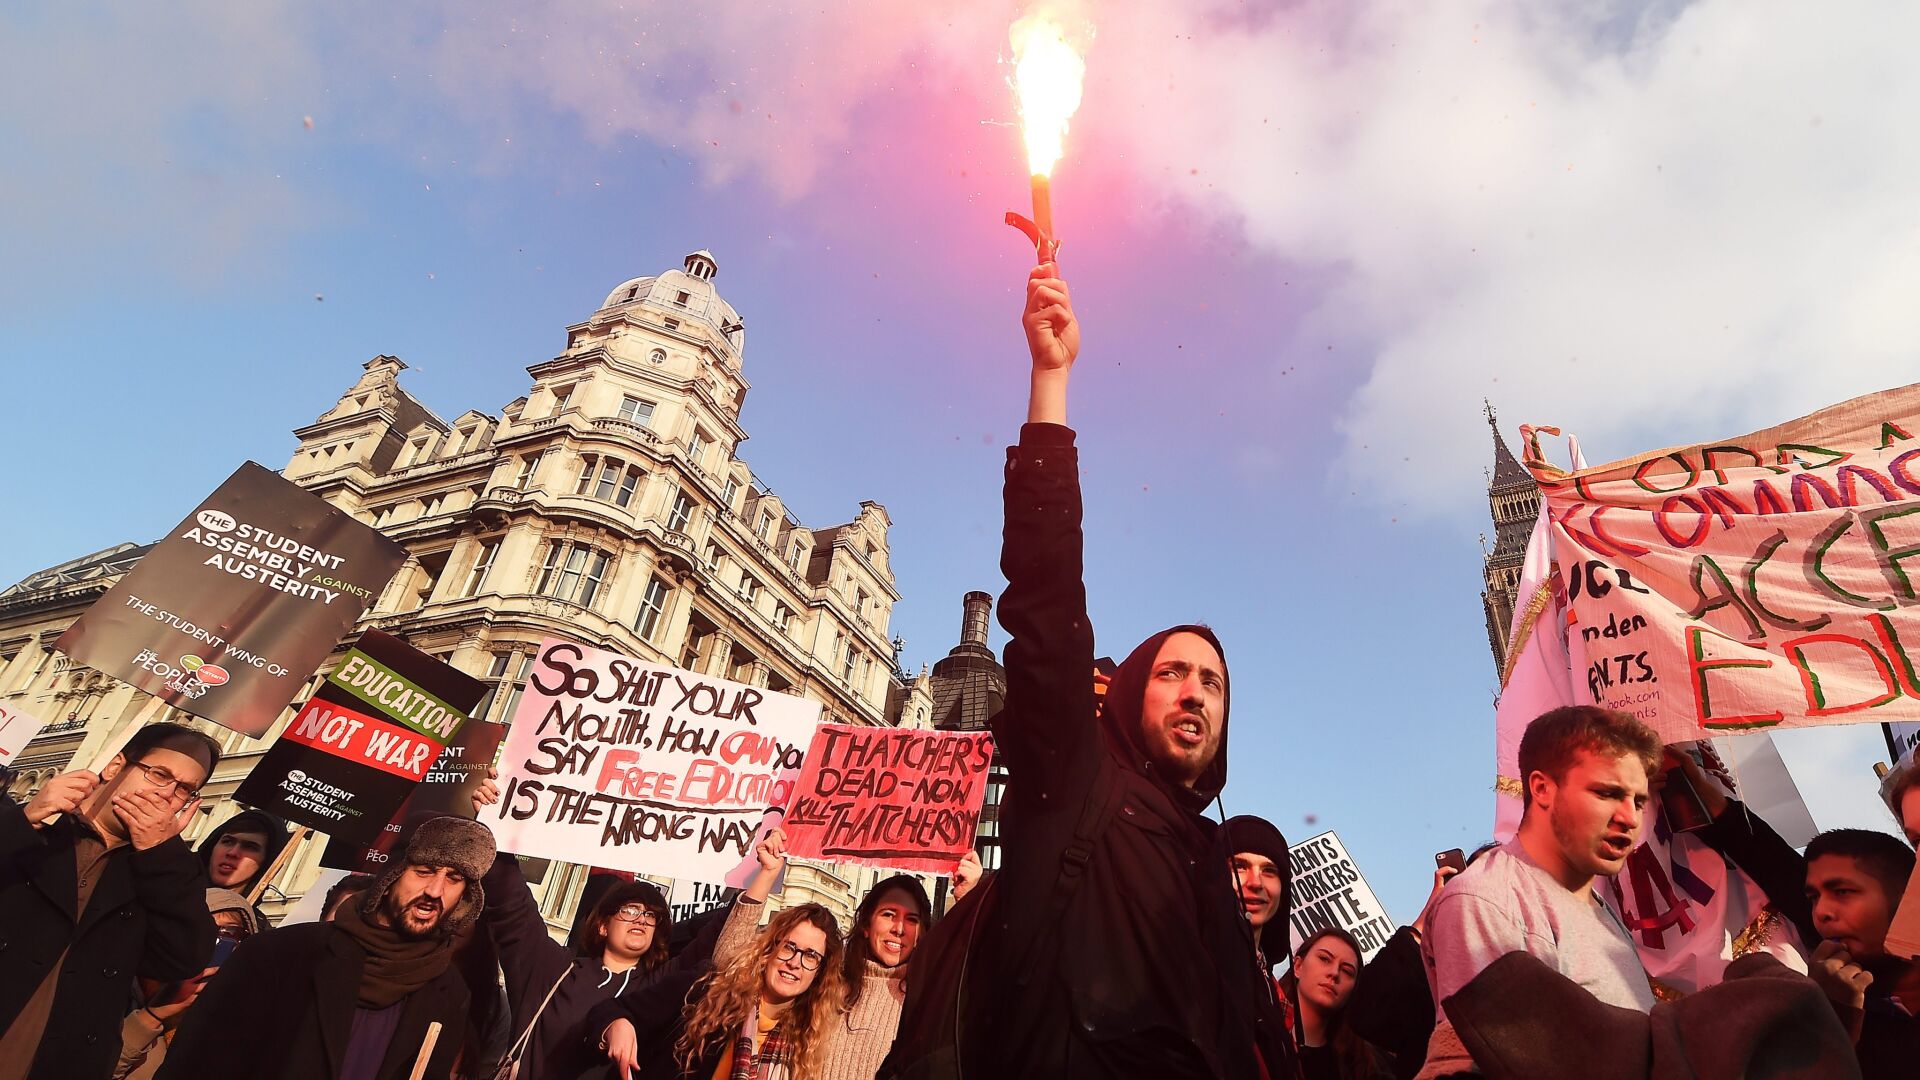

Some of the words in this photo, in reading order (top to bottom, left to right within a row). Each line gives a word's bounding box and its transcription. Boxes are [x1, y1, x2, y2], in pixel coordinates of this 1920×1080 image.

[201, 513, 231, 529] THE
[235, 523, 346, 571] STUDENT
[181, 526, 313, 580] ASSEMBLY
[311, 573, 373, 601] AGAINST
[203, 552, 341, 605] AUSTERITY
[126, 594, 155, 617] THE
[154, 609, 225, 648] STUDENT
[223, 642, 268, 670] WING
[266, 662, 289, 679] OF
[142, 647, 159, 659] THE
[163, 680, 200, 700] ASSEMBLY
[336, 655, 461, 739] EDUCATION
[592, 659, 672, 707] SHUT
[671, 675, 763, 725] YOUR
[295, 707, 364, 750] NOT
[364, 729, 430, 775] WAR
[656, 716, 720, 757] HOW
[448, 763, 488, 771] AGAINST
[524, 737, 600, 776] SAY
[304, 777, 355, 802] STUDENT
[420, 772, 469, 783] ERITY
[278, 780, 338, 807] ASSEMBLY
[335, 803, 364, 817] AGAINST
[284, 794, 346, 821] AUSTERITY
[499, 777, 546, 820] IS
[545, 784, 604, 825] THE
[600, 803, 698, 848] WRONG
[789, 795, 832, 821] KILL
[366, 852, 389, 863] PEO
[693, 881, 721, 903] TAX
[1289, 887, 1368, 940] UNITE
